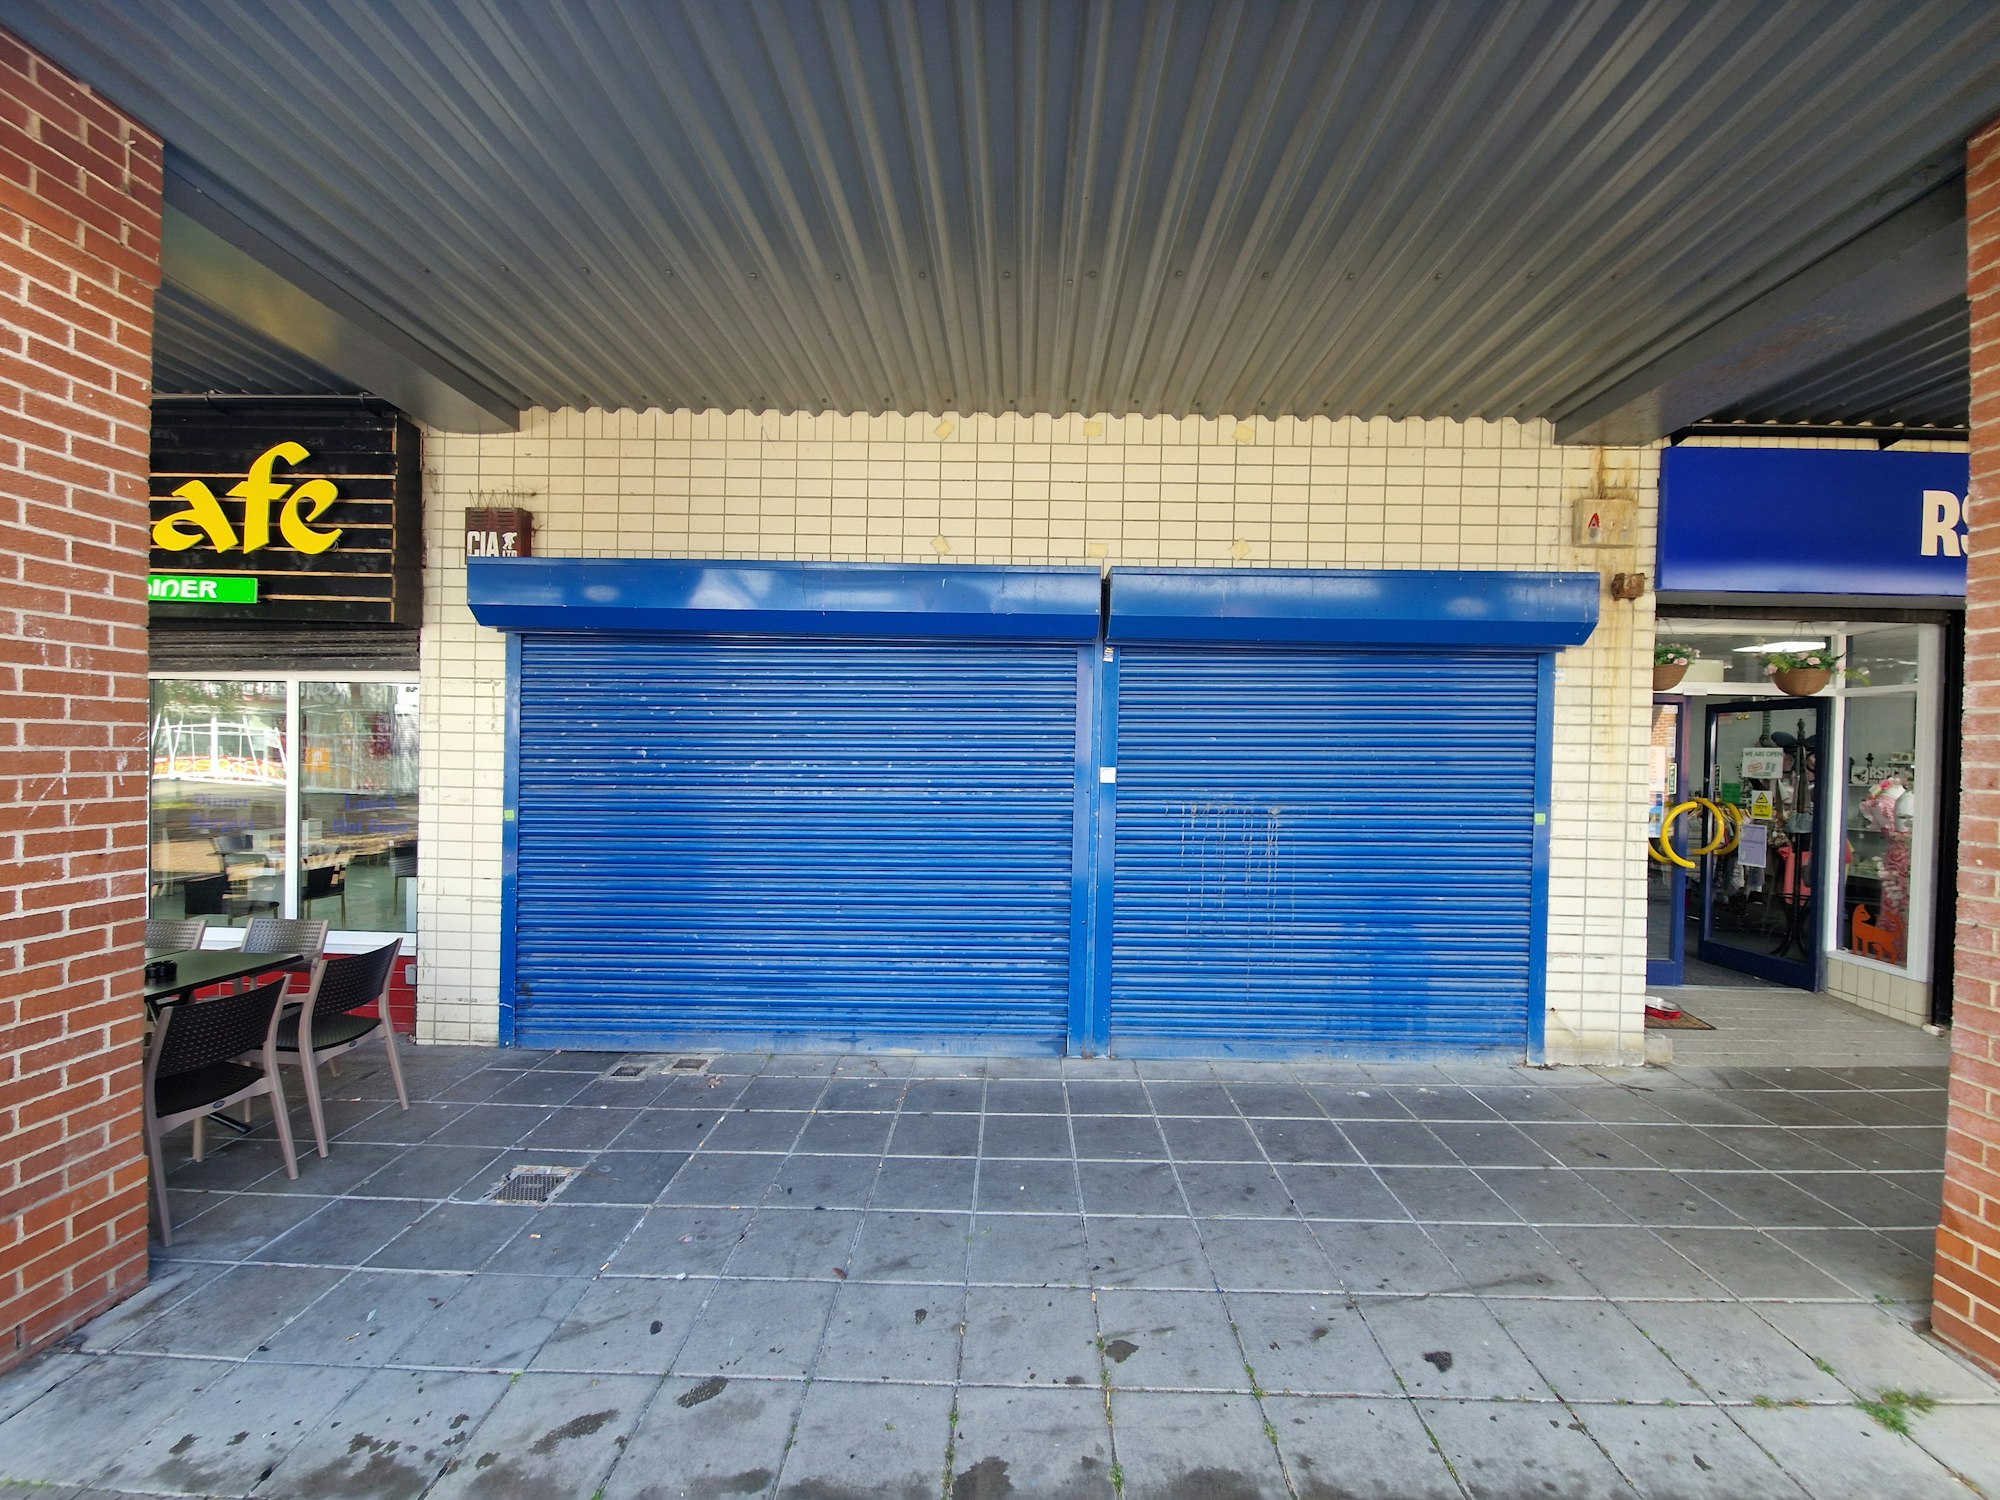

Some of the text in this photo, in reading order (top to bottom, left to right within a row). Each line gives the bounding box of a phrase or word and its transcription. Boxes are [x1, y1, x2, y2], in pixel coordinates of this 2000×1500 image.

[1920, 490, 1969, 556] R
[467, 531, 500, 557] CIA
[148, 578, 218, 599] INER
